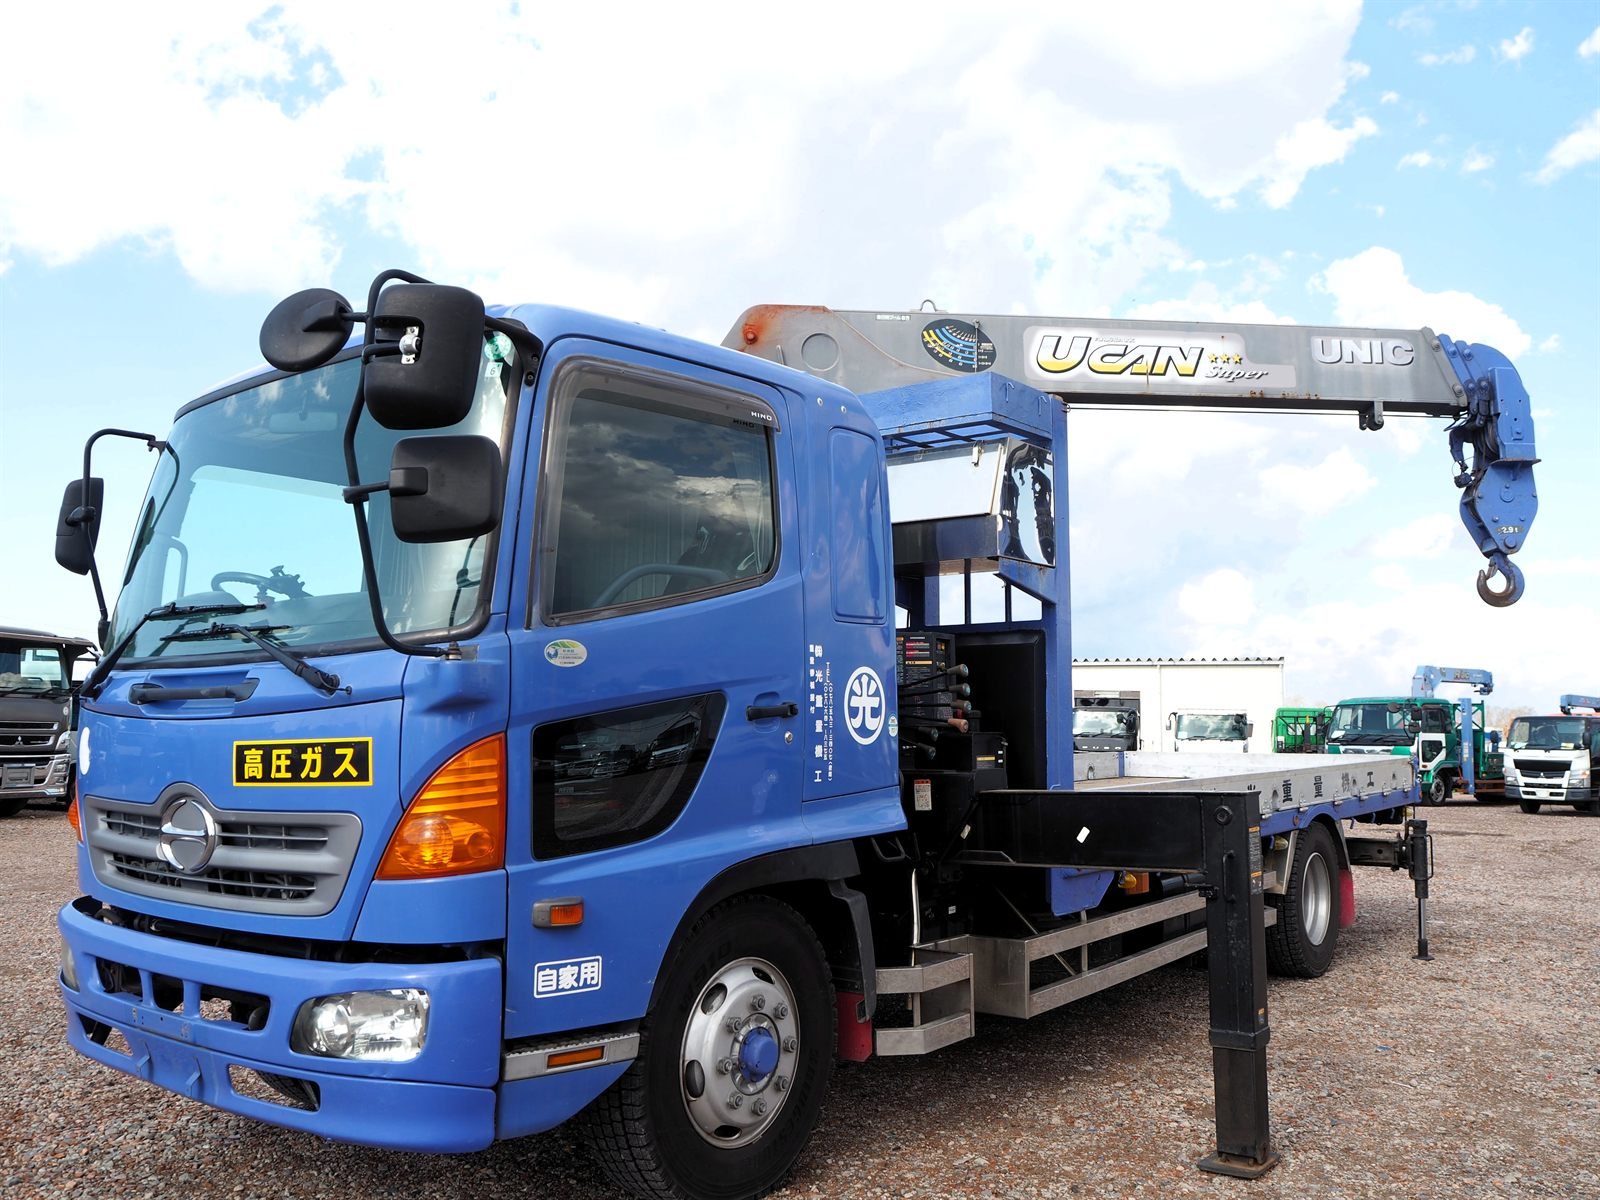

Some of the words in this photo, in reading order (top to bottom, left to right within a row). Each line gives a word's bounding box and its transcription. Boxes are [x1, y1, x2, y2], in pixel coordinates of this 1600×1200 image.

[1037, 335, 1204, 376] UCAN
[1316, 338, 1415, 366] UNIC
[1204, 366, 1269, 382] Super
[751, 411, 773, 421] HINO
[850, 674, 881, 731] 光
[244, 746, 359, 779] 高圧ガス
[537, 961, 599, 992] 自家用
